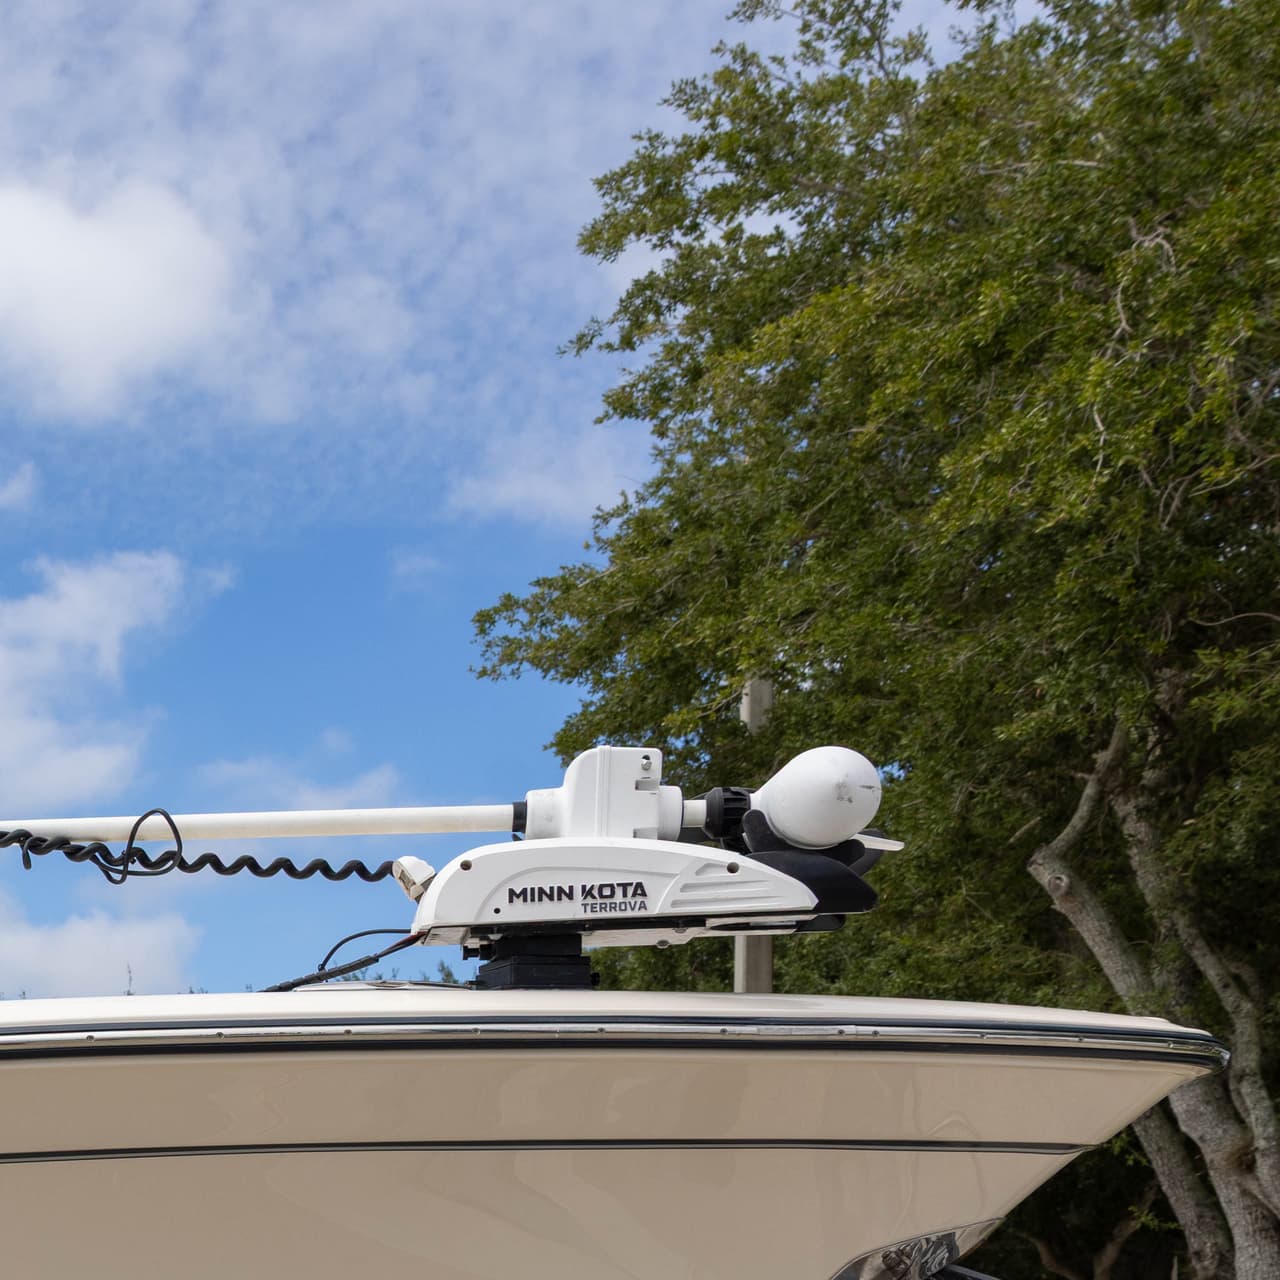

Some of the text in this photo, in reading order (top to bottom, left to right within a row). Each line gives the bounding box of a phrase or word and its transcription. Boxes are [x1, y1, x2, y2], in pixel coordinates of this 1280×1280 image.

[508, 881, 648, 904] MINN KOTA
[581, 901, 648, 913] TERROVA
